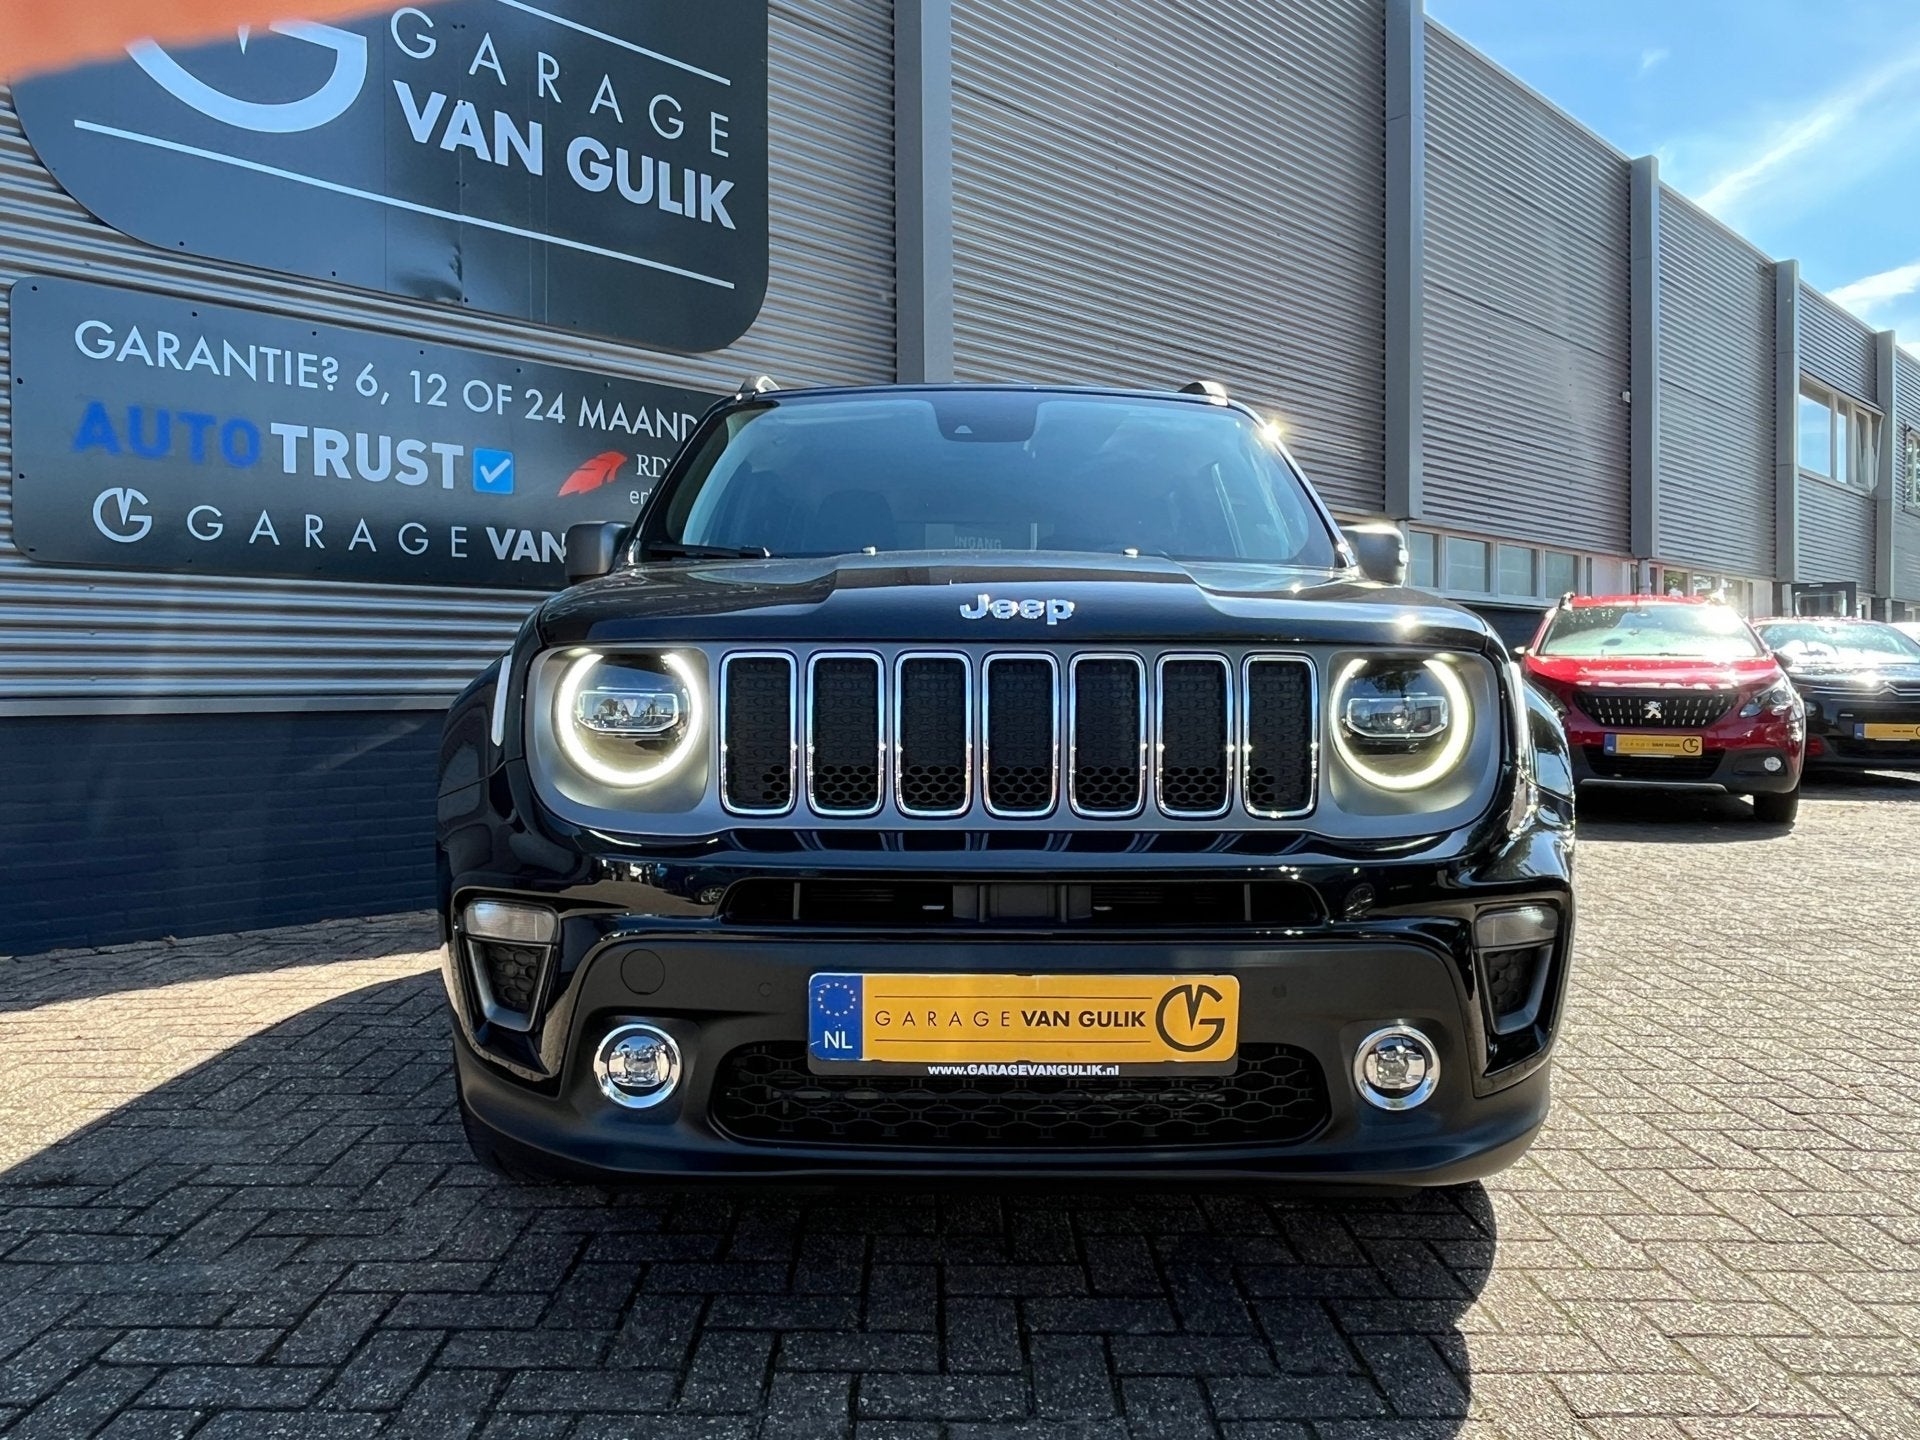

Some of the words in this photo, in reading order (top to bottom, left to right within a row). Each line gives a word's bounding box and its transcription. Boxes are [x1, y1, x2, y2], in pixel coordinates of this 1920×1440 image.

[390, 7, 729, 158] GARAGE
[393, 79, 543, 177] VAN
[567, 136, 737, 230] GULIK
[74, 319, 340, 392] GARANTIE?
[355, 362, 390, 405] 6,
[409, 370, 448, 407] 12
[462, 379, 513, 415] OF
[524, 388, 566, 424] 24
[186, 504, 468, 559] GARAGE
[485, 526, 567, 565] VAN
[959, 593, 1075, 625] Jeep
[823, 1030, 853, 1049] NL
[874, 1010, 1010, 1028] GARAGE
[1020, 1010, 1070, 1028] VAN
[1078, 1010, 1147, 1028] GULIK
[927, 1063, 1119, 1077] www.GARAGEVANGULIK.nl
